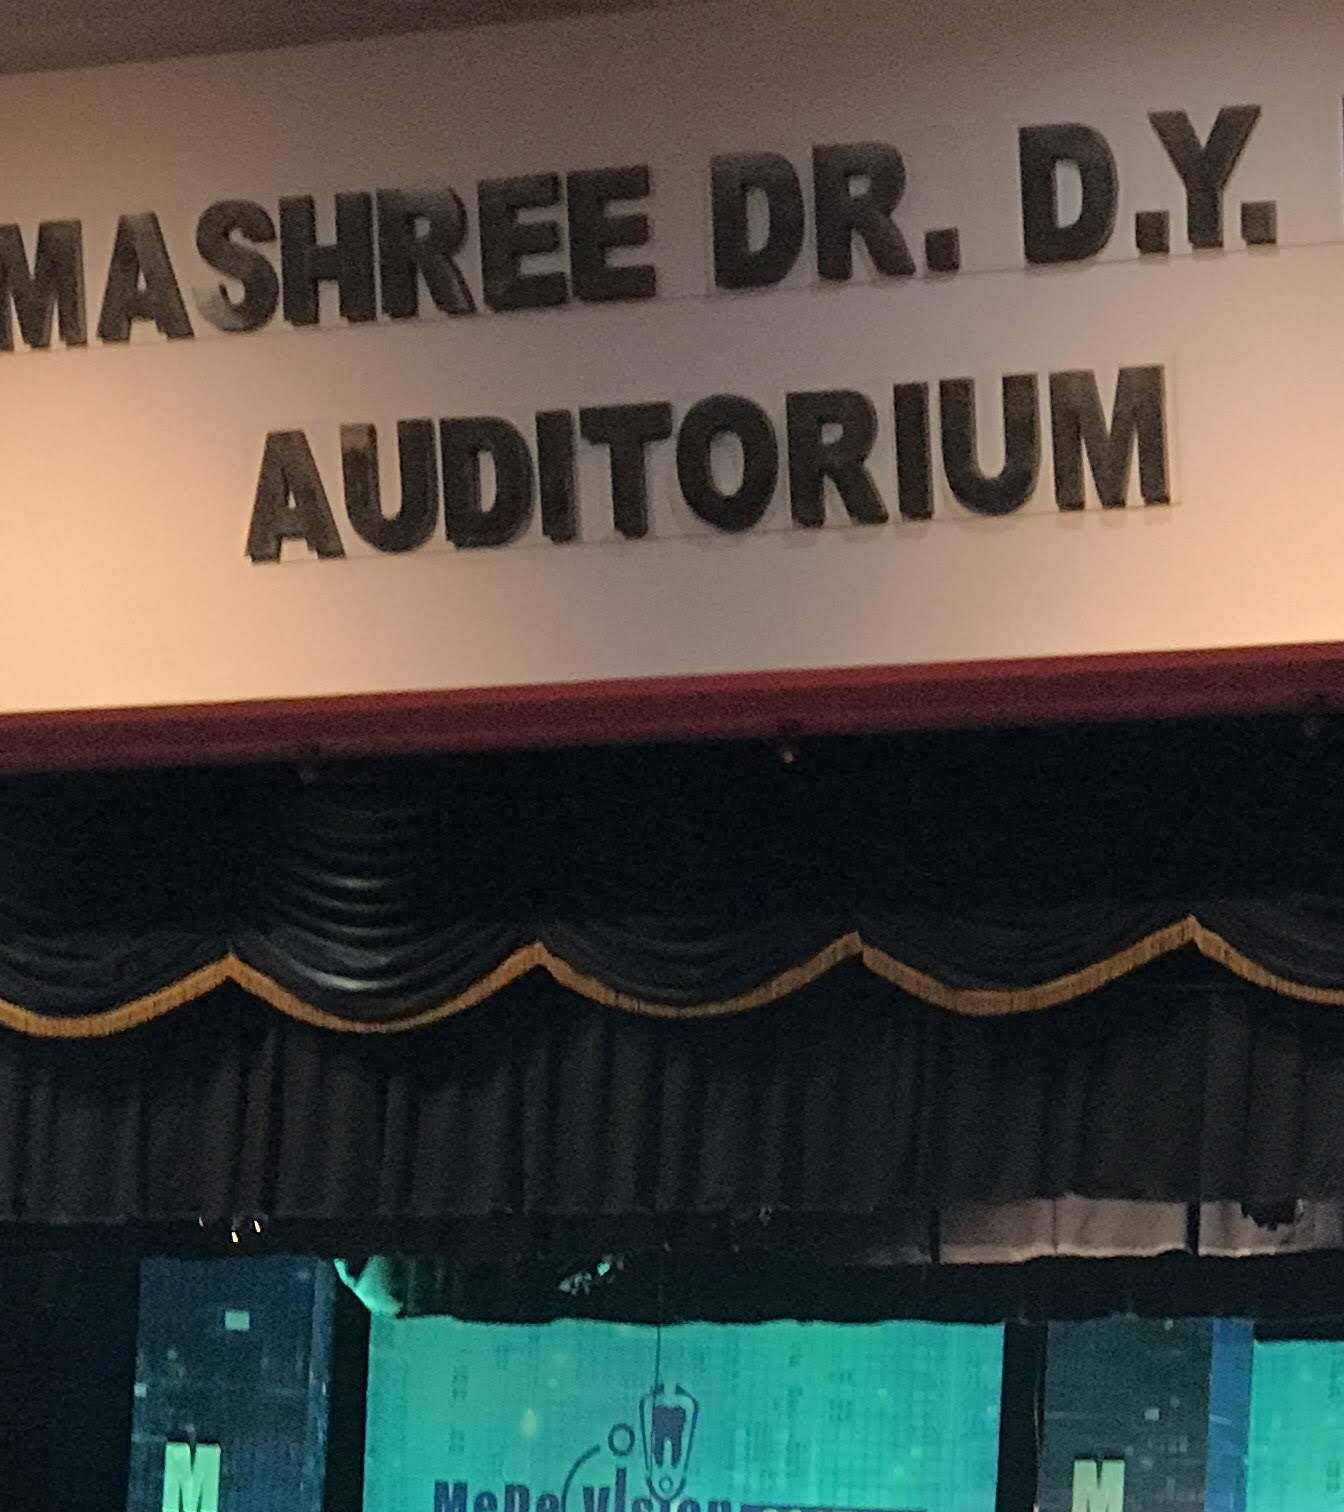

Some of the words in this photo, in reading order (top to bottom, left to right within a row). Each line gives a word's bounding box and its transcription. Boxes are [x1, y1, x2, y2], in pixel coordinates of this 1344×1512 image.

[710, 138, 962, 291] DR.
[1017, 104, 1278, 268] D.Y.
[244, 364, 1174, 566] AUDITORIUM
